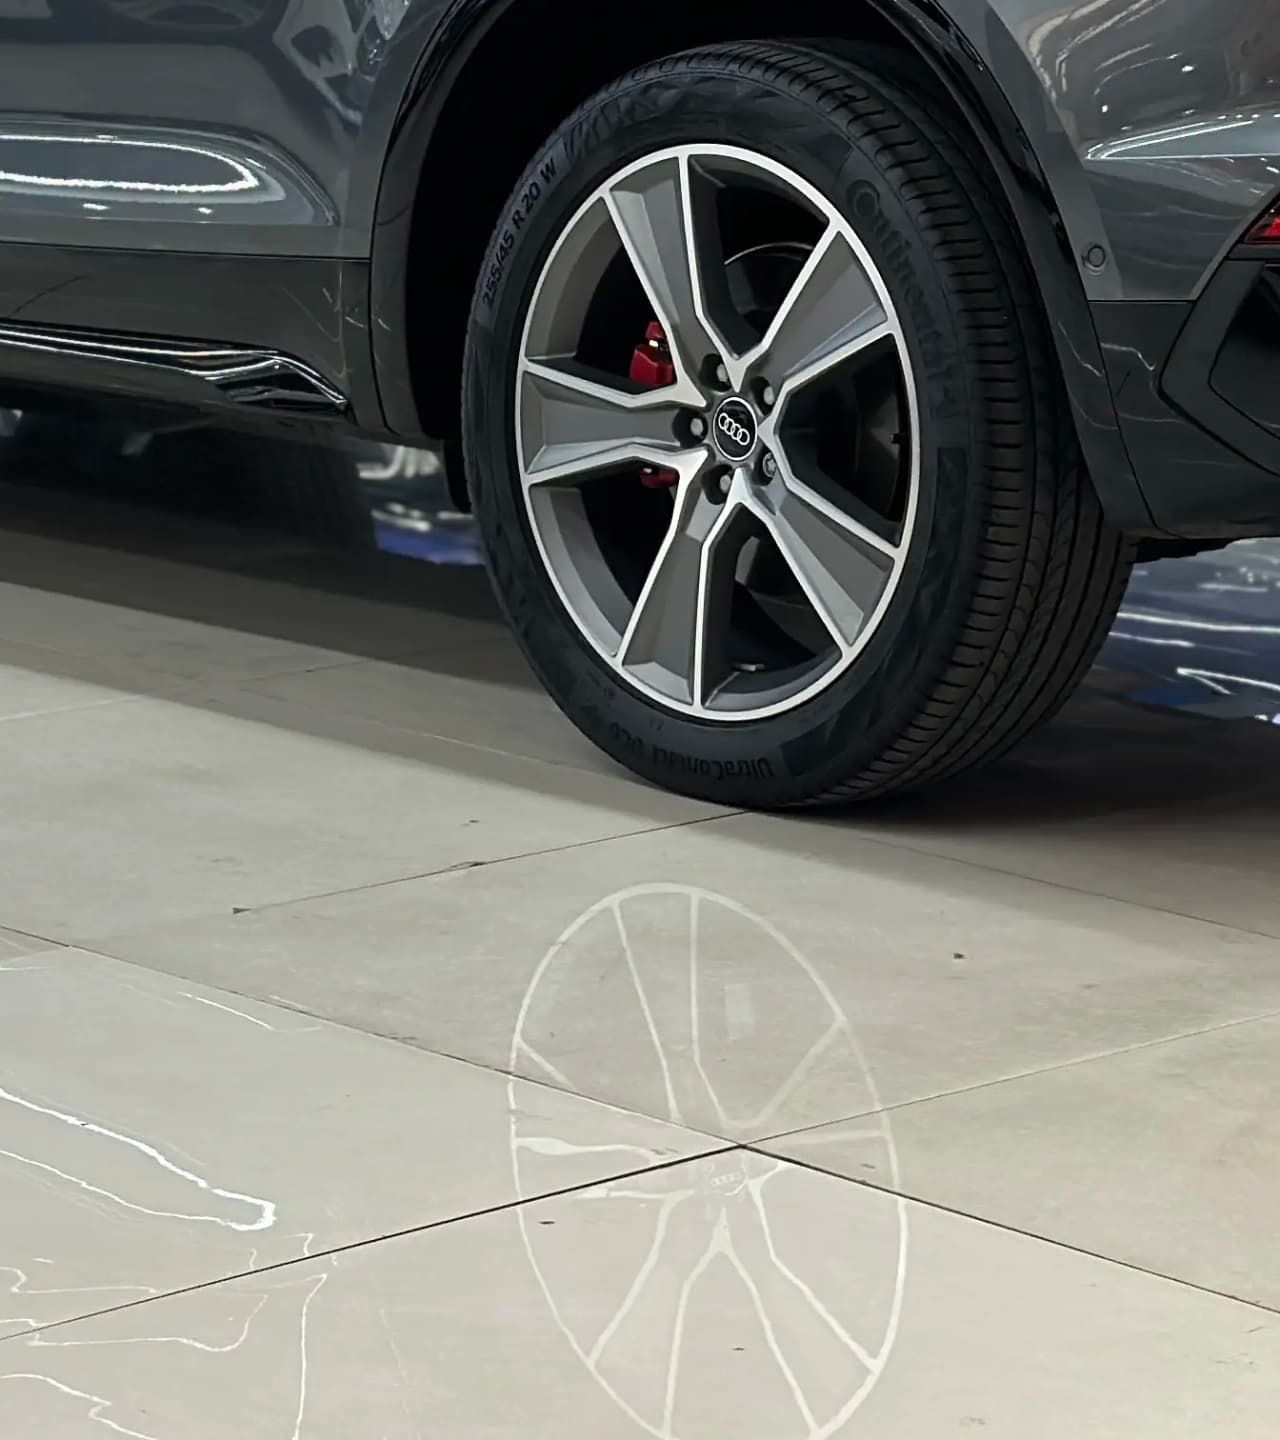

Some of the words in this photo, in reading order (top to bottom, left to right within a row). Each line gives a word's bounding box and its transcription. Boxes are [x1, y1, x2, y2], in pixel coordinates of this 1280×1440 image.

[482, 230, 515, 306] 255/45
[512, 209, 525, 230] R
[521, 181, 541, 211] 20
[539, 157, 557, 185] W
